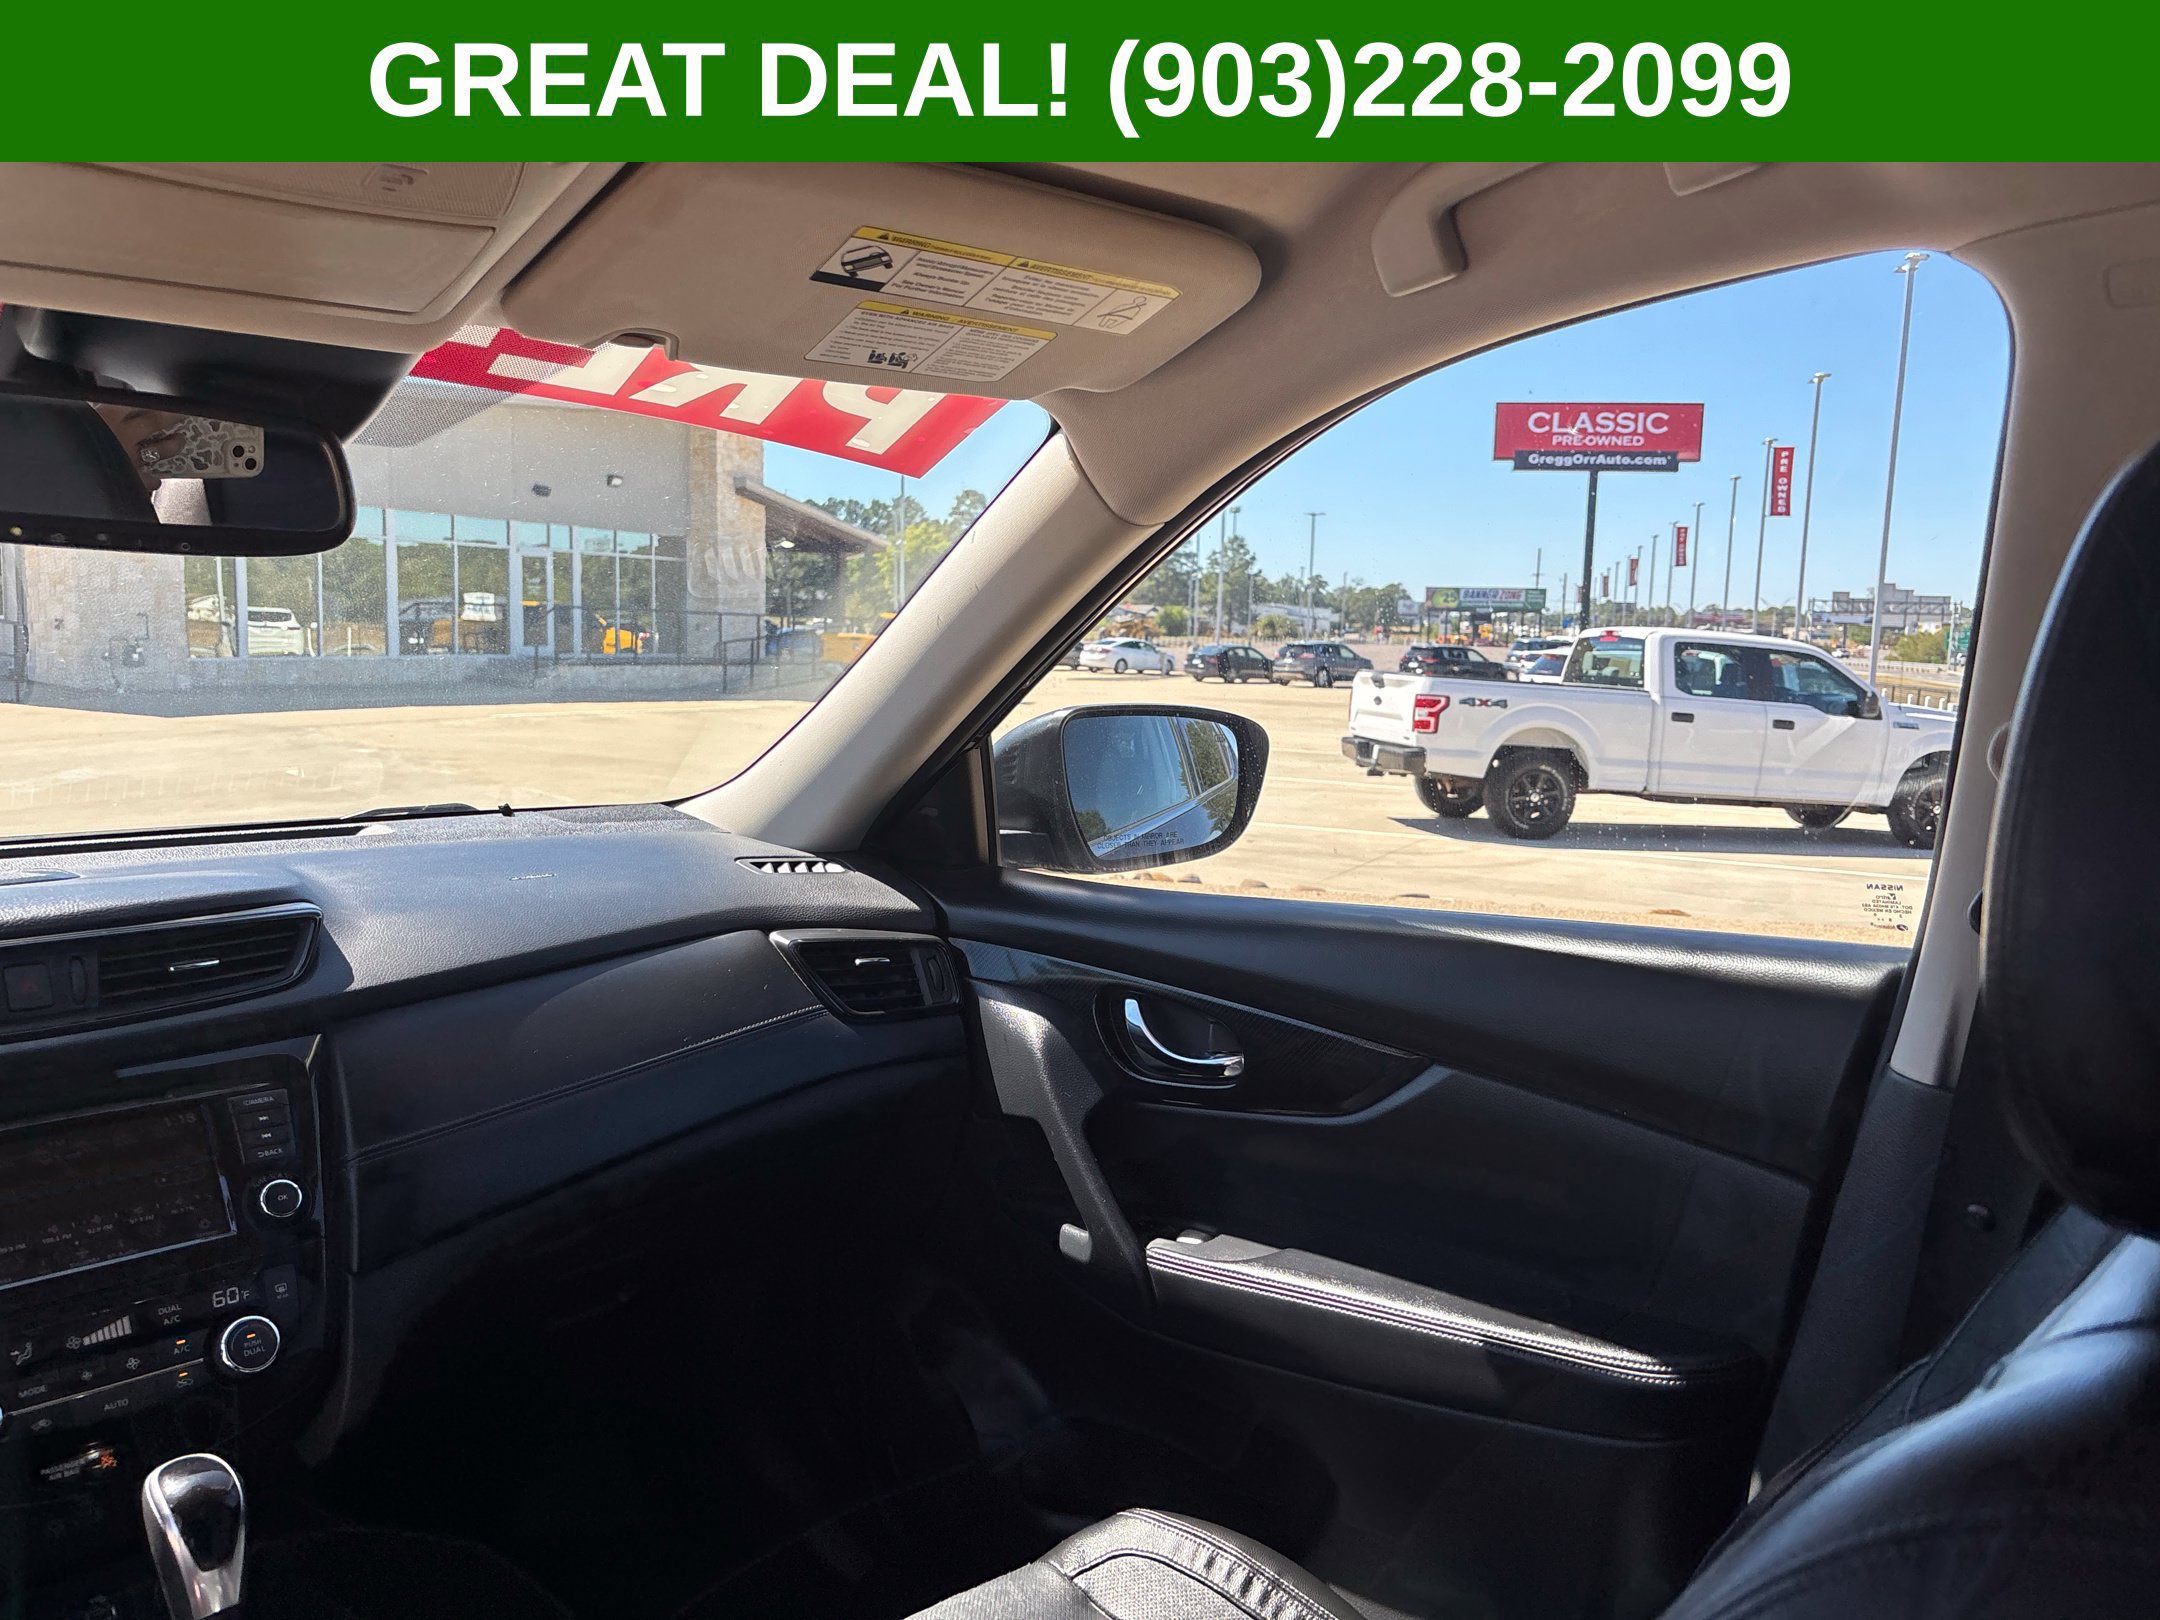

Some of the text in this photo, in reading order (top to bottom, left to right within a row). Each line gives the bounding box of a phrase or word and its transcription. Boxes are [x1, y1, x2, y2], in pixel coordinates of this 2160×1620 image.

[911, 310, 949, 322] WARNING
[1528, 412, 1670, 434] CLASSIC
[1552, 435, 1644, 446] PRE-OWNED
[1777, 450, 1789, 512] PRE OWNED
[1462, 588, 1500, 599] BANNER
[264, 1148, 283, 1156] BACK
[277, 1194, 288, 1202] OK
[158, 1304, 182, 1316] DUAL
[164, 1315, 181, 1326] A/C
[244, 1340, 262, 1348] PUSH
[174, 1345, 191, 1355] A/C
[244, 1346, 266, 1357] DUAL
[18, 1385, 48, 1398] MODE
[104, 1398, 129, 1411] AUTO
